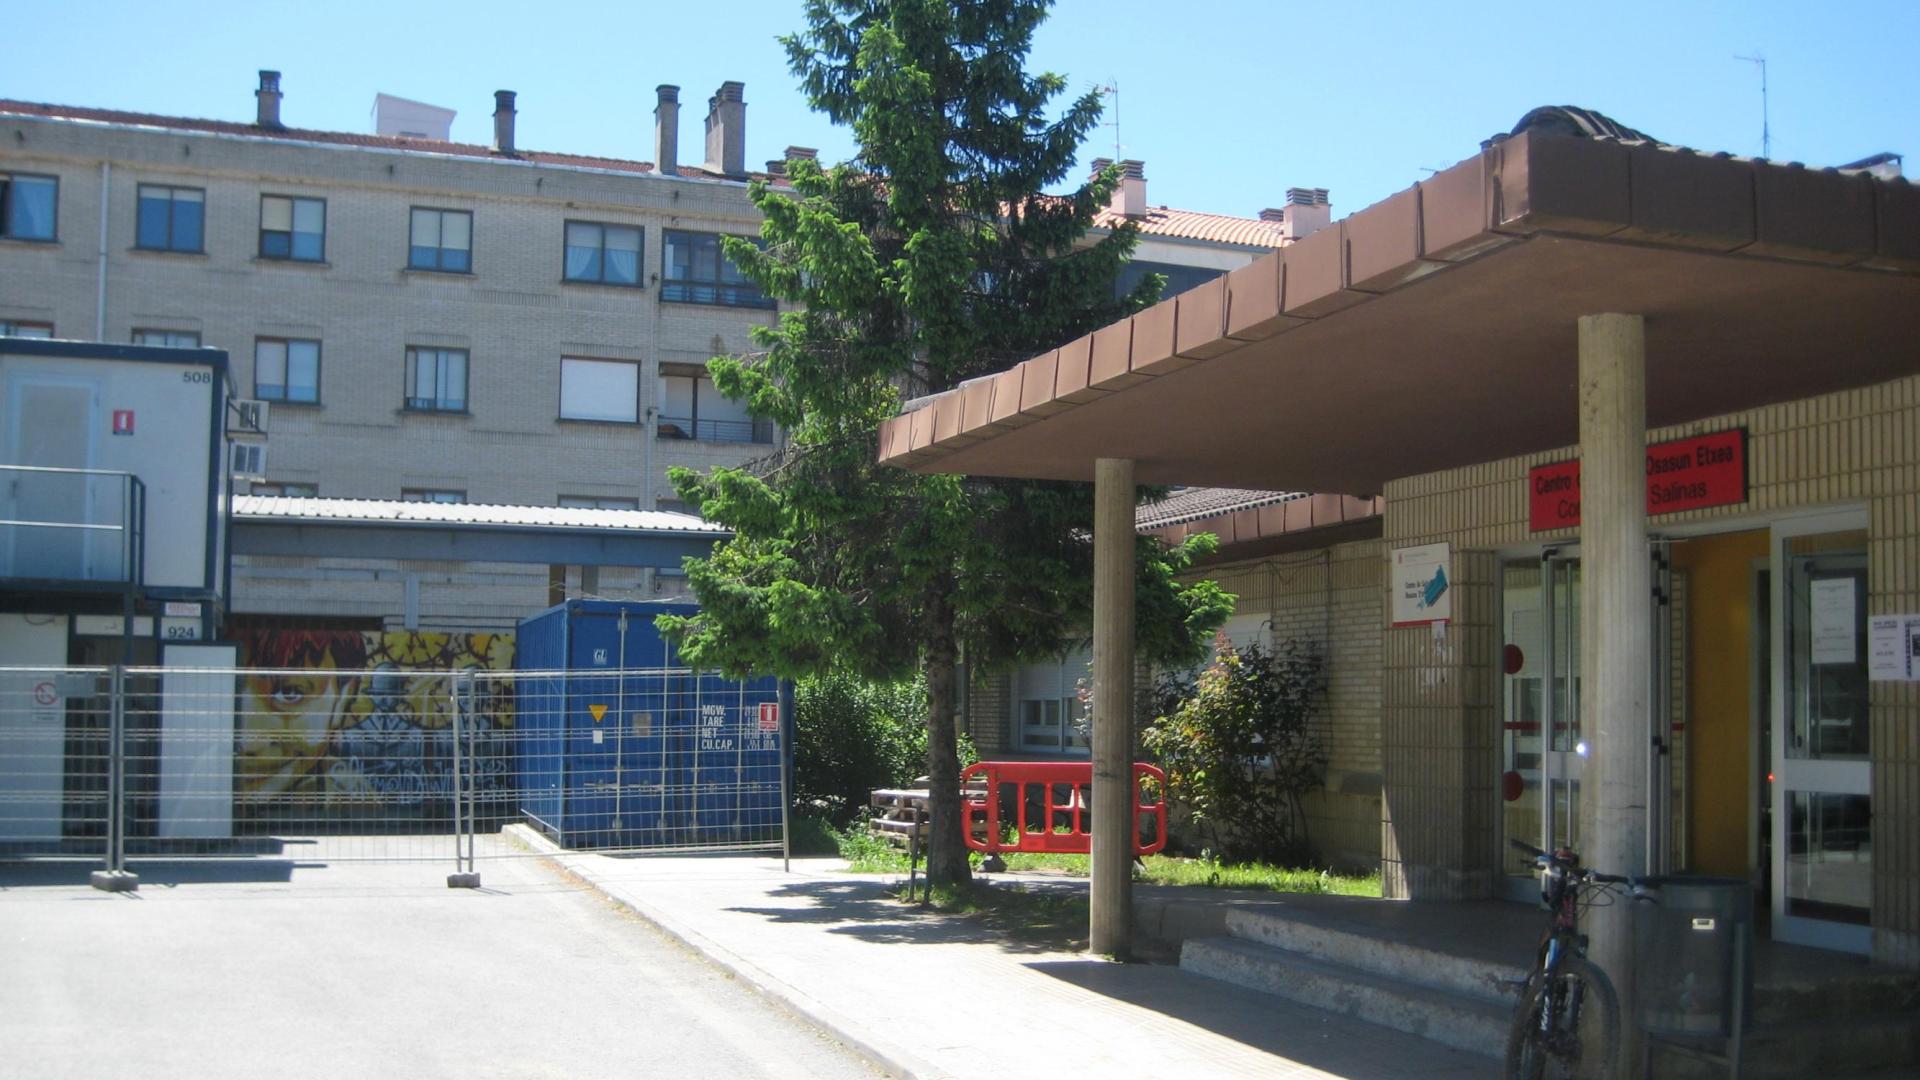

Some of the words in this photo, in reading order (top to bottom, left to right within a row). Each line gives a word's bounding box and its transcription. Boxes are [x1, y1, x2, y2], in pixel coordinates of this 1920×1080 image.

[183, 371, 211, 384] 508
[1535, 474, 1572, 495] Centro
[1696, 446, 1733, 467] Etxea
[1650, 482, 1707, 505] Salinas
[168, 626, 194, 639] 924
[703, 716, 724, 727] TARE
[701, 727, 718, 738] NET
